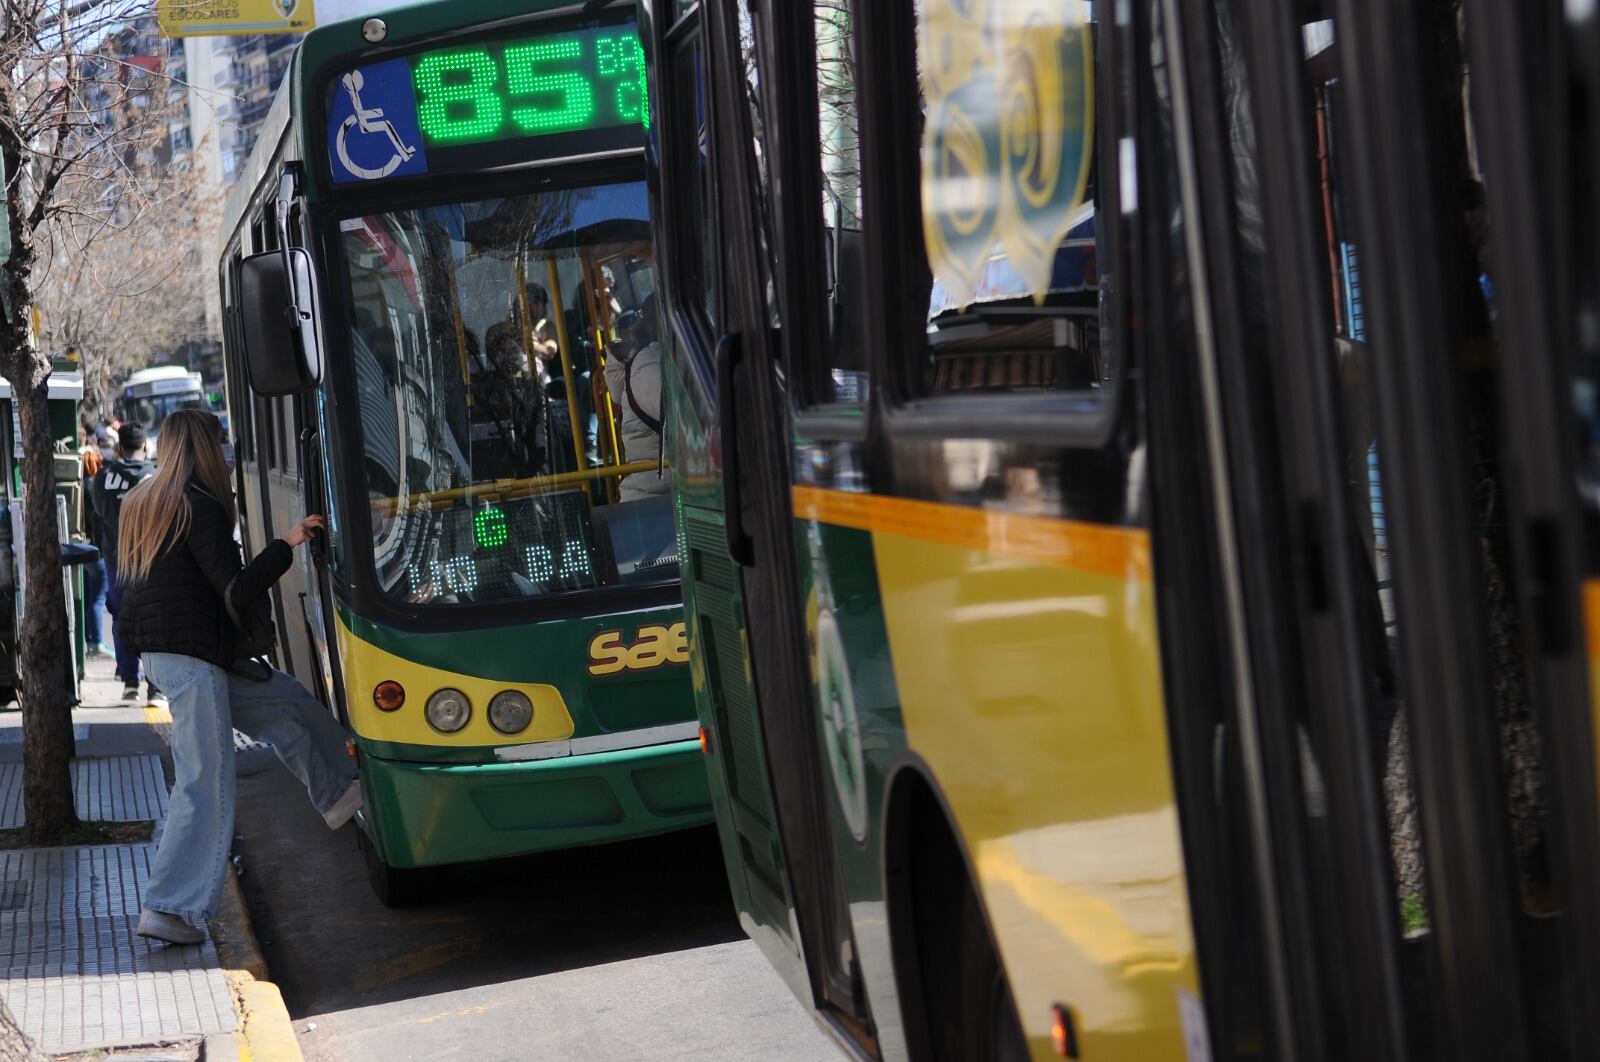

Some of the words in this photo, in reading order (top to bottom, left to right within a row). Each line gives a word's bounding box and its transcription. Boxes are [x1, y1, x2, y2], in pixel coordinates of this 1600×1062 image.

[169, 9, 240, 21] ESCOLARES
[415, 39, 594, 140] 85
[597, 36, 640, 74] BA
[474, 507, 509, 549] G
